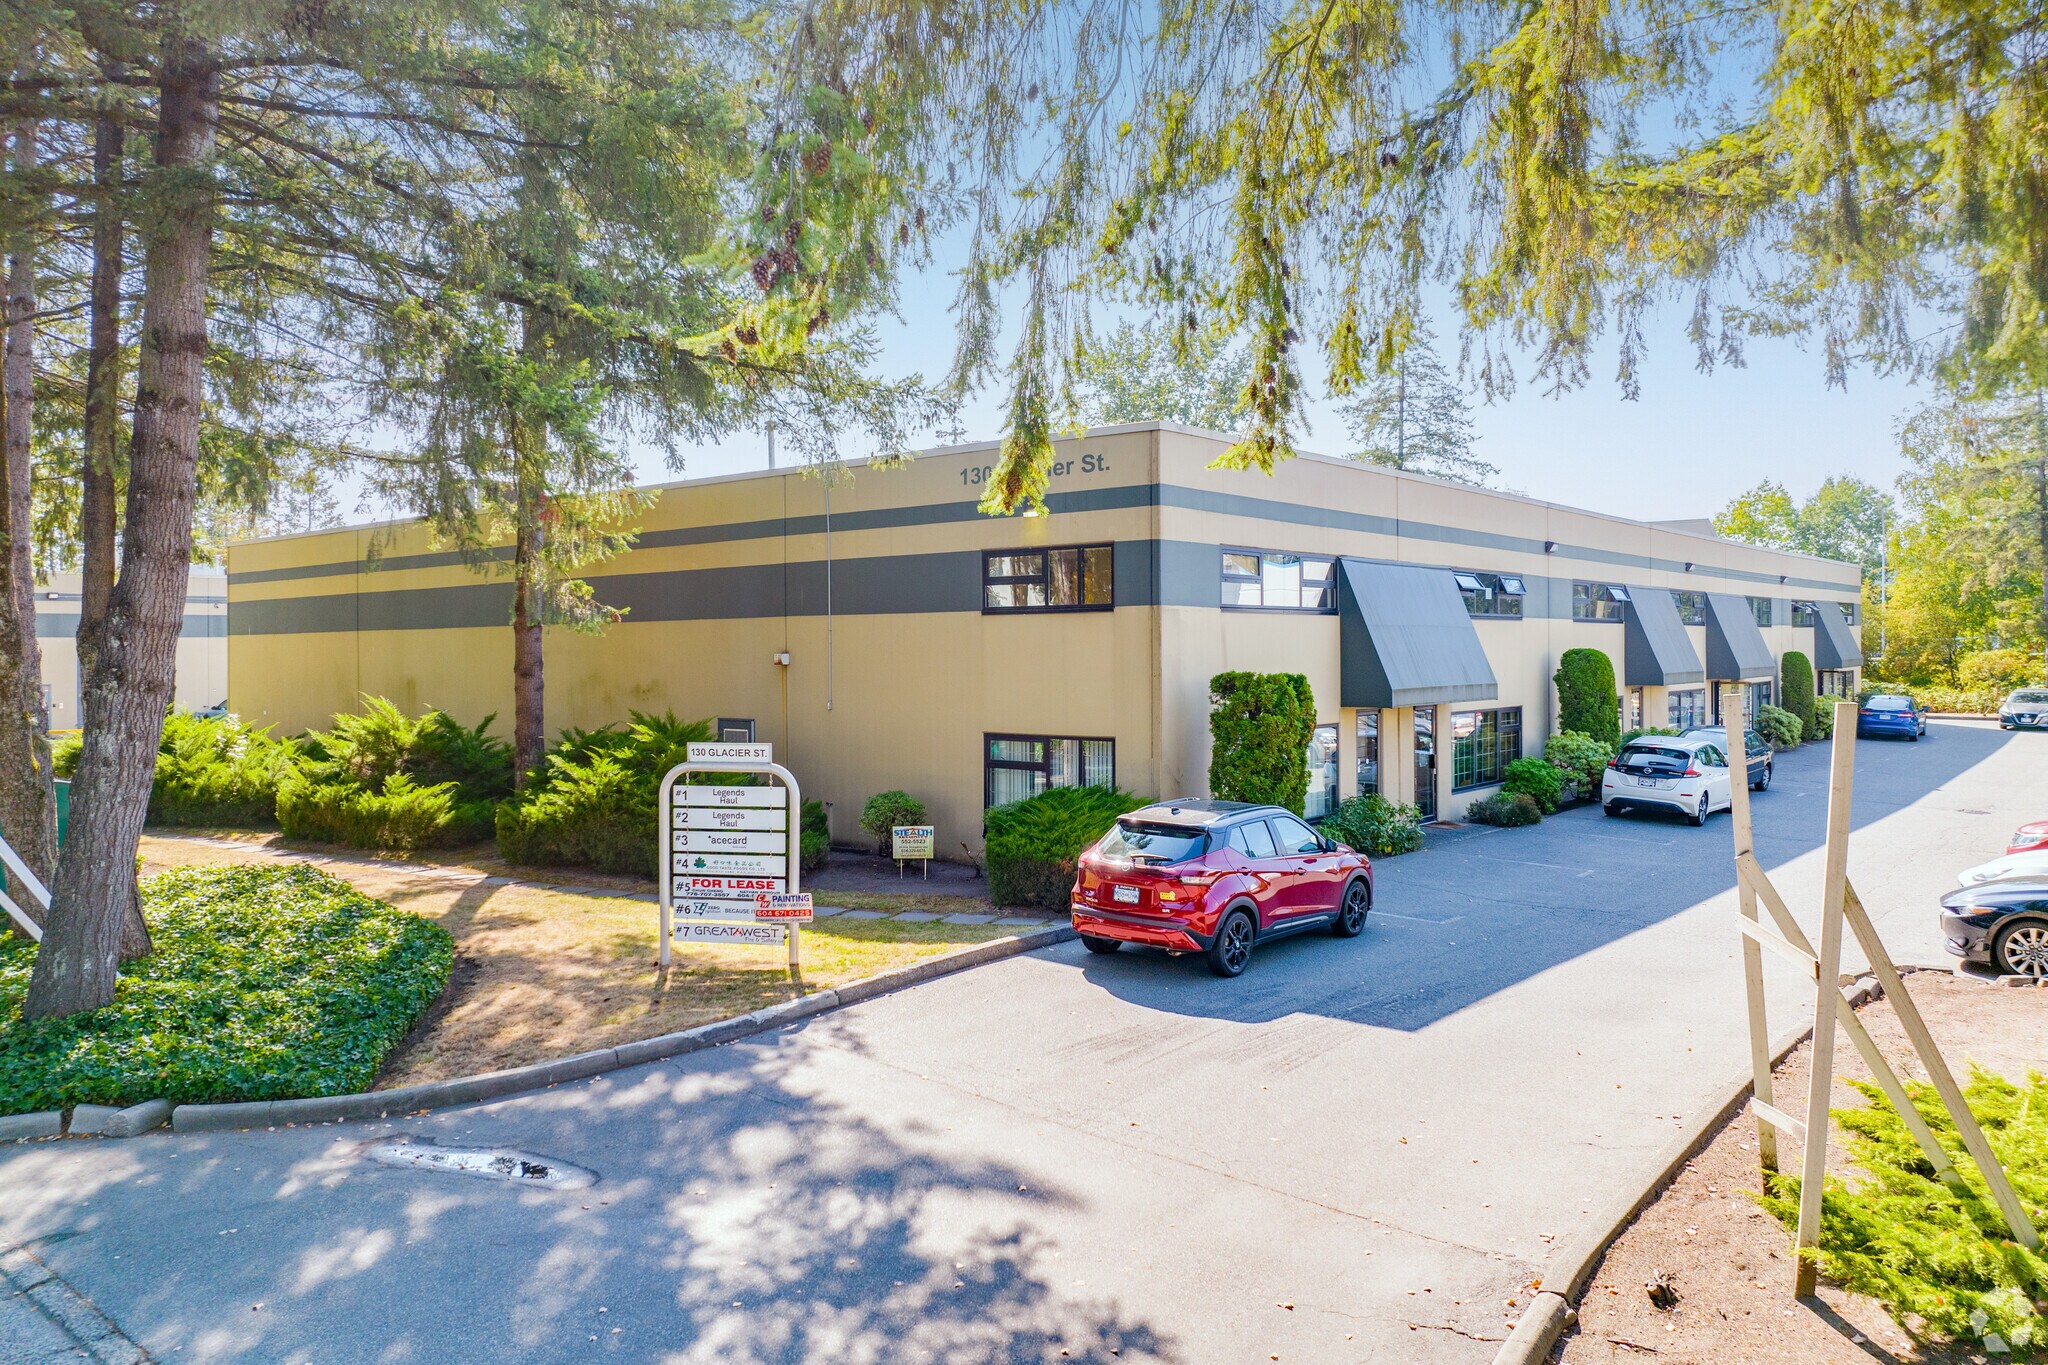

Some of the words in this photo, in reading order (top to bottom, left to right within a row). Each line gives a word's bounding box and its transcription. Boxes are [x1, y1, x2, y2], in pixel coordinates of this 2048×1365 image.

[1081, 453, 1110, 473] St.
[691, 748, 706, 757] 130
[708, 748, 751, 757] GLACIER
[753, 749, 768, 758] ST.
[675, 790, 688, 801] #1
[712, 788, 745, 798] Legends
[675, 812, 688, 823] #2
[712, 812, 745, 821] Legends
[675, 835, 688, 846] #3
[676, 859, 689, 869] #4
[676, 881, 691, 892] #5
[692, 879, 722, 888] FOR
[728, 880, 775, 890] LEASE
[676, 904, 691, 914] #6
[676, 926, 690, 937] #7
